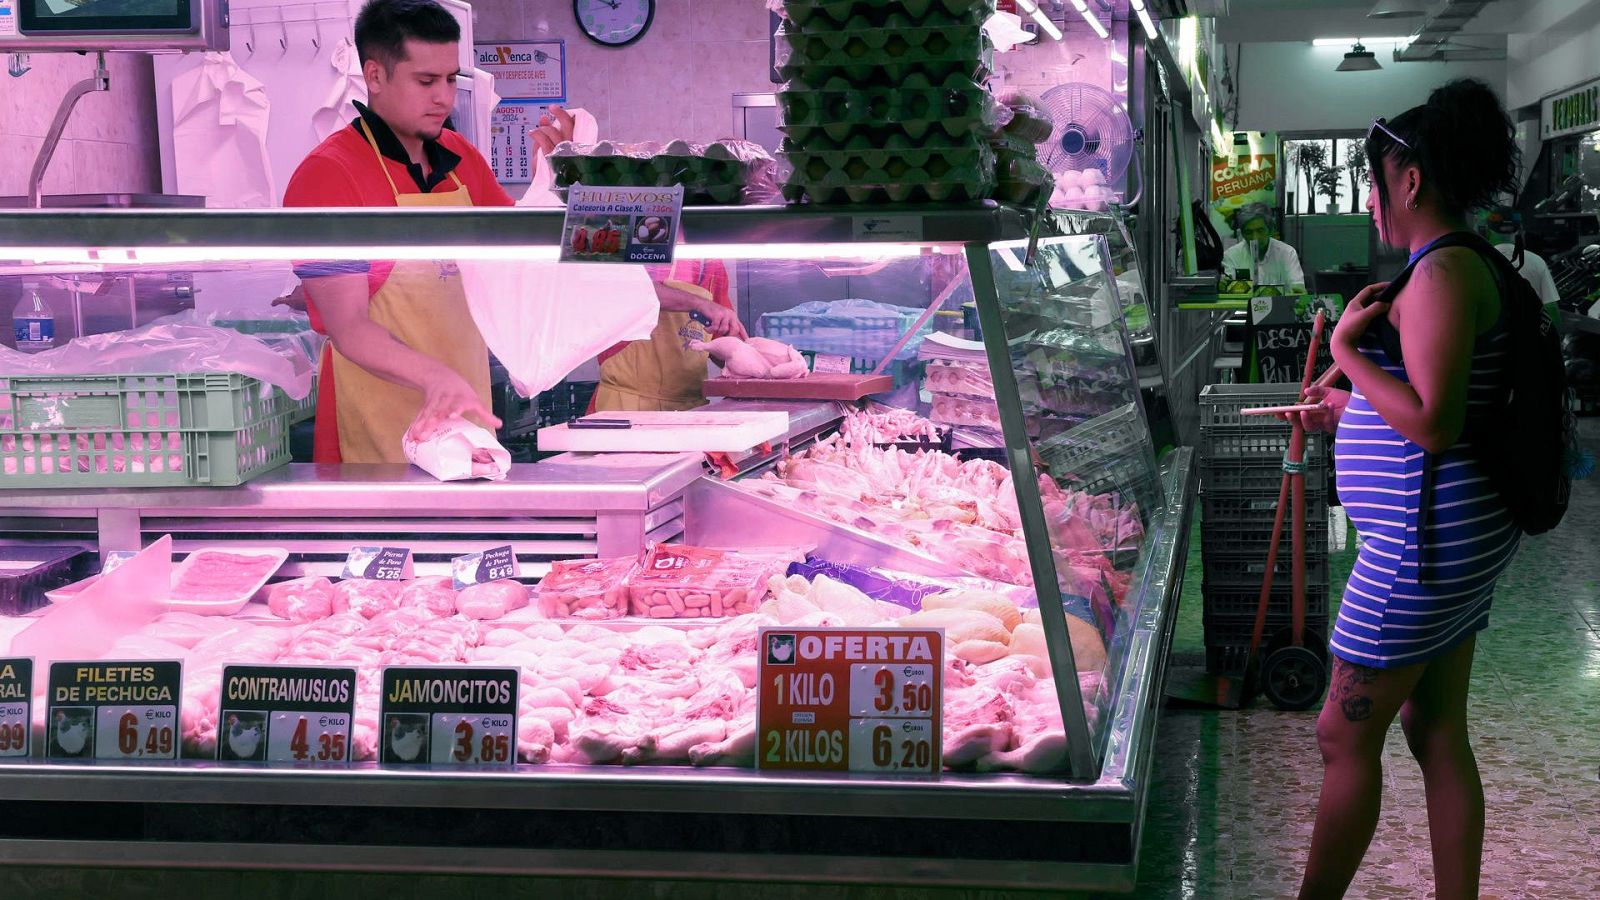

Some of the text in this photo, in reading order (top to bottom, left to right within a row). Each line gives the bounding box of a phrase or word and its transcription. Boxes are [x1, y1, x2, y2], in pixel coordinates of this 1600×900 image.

[502, 114, 519, 122] 2024
[506, 136, 511, 145] 8
[505, 147, 513, 156] 15
[520, 147, 527, 156] 16
[505, 158, 513, 167] 22
[520, 157, 528, 167] 23
[1213, 157, 1273, 182] COCINA
[505, 168, 513, 178] 29
[520, 168, 528, 178] 30
[1216, 171, 1273, 196] PERUANA
[579, 191, 673, 203] HUEVOS
[614, 204, 633, 212] Clase
[633, 205, 643, 213] XL
[799, 636, 933, 660] OFERTA
[76, 667, 155, 682] FILETES
[56, 685, 172, 702] DE PECHUGA
[228, 676, 349, 703] CONTRAMUSLOS
[389, 679, 511, 704] JAMONCITOS
[774, 672, 835, 705] 1 KILO
[874, 669, 931, 714] 3,50
[7, 708, 23, 716] KILO
[155, 711, 172, 719] KILO
[328, 718, 345, 726] KILO
[491, 719, 508, 727] KILO
[118, 712, 173, 757] 6,49
[766, 730, 843, 763] 2 KILOS
[872, 725, 930, 769] 6,20
